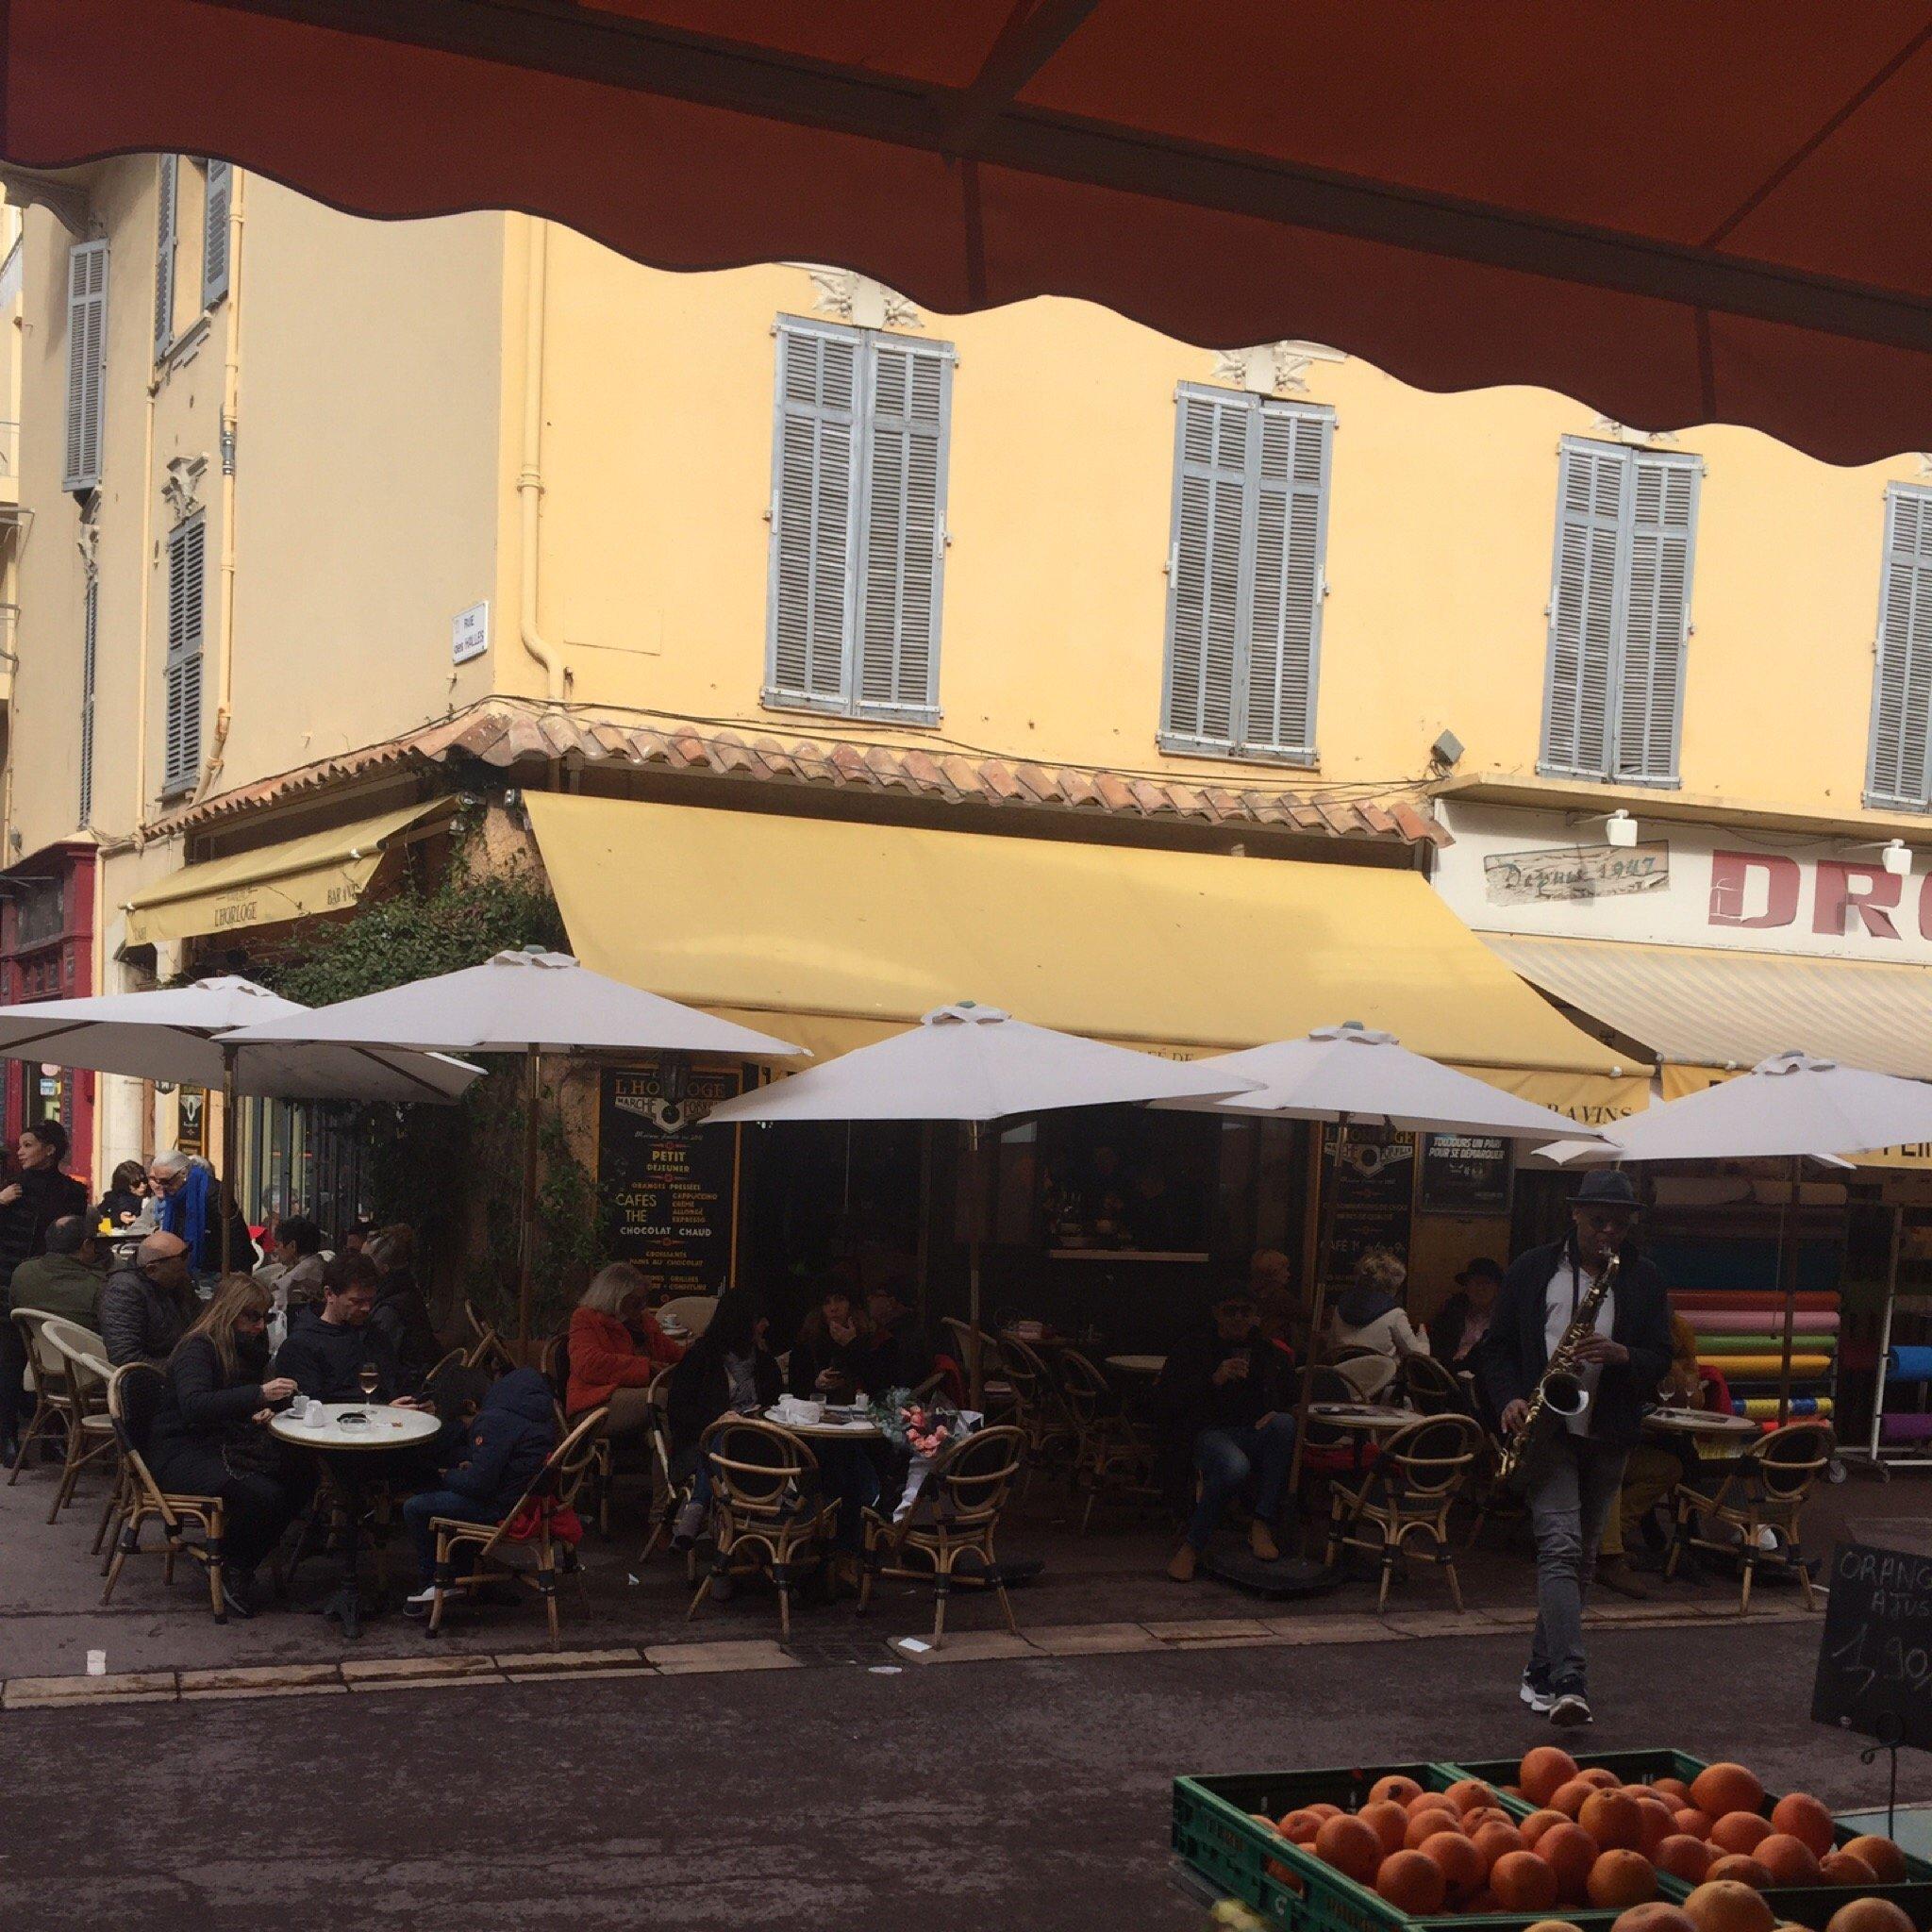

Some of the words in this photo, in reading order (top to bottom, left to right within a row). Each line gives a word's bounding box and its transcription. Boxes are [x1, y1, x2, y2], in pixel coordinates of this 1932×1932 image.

[1599, 857, 1657, 880] 1947
[653, 1151, 687, 1162] PETIT
[620, 1226, 672, 1236] CHOCOLAT
[678, 1227, 712, 1237] CHAUD
